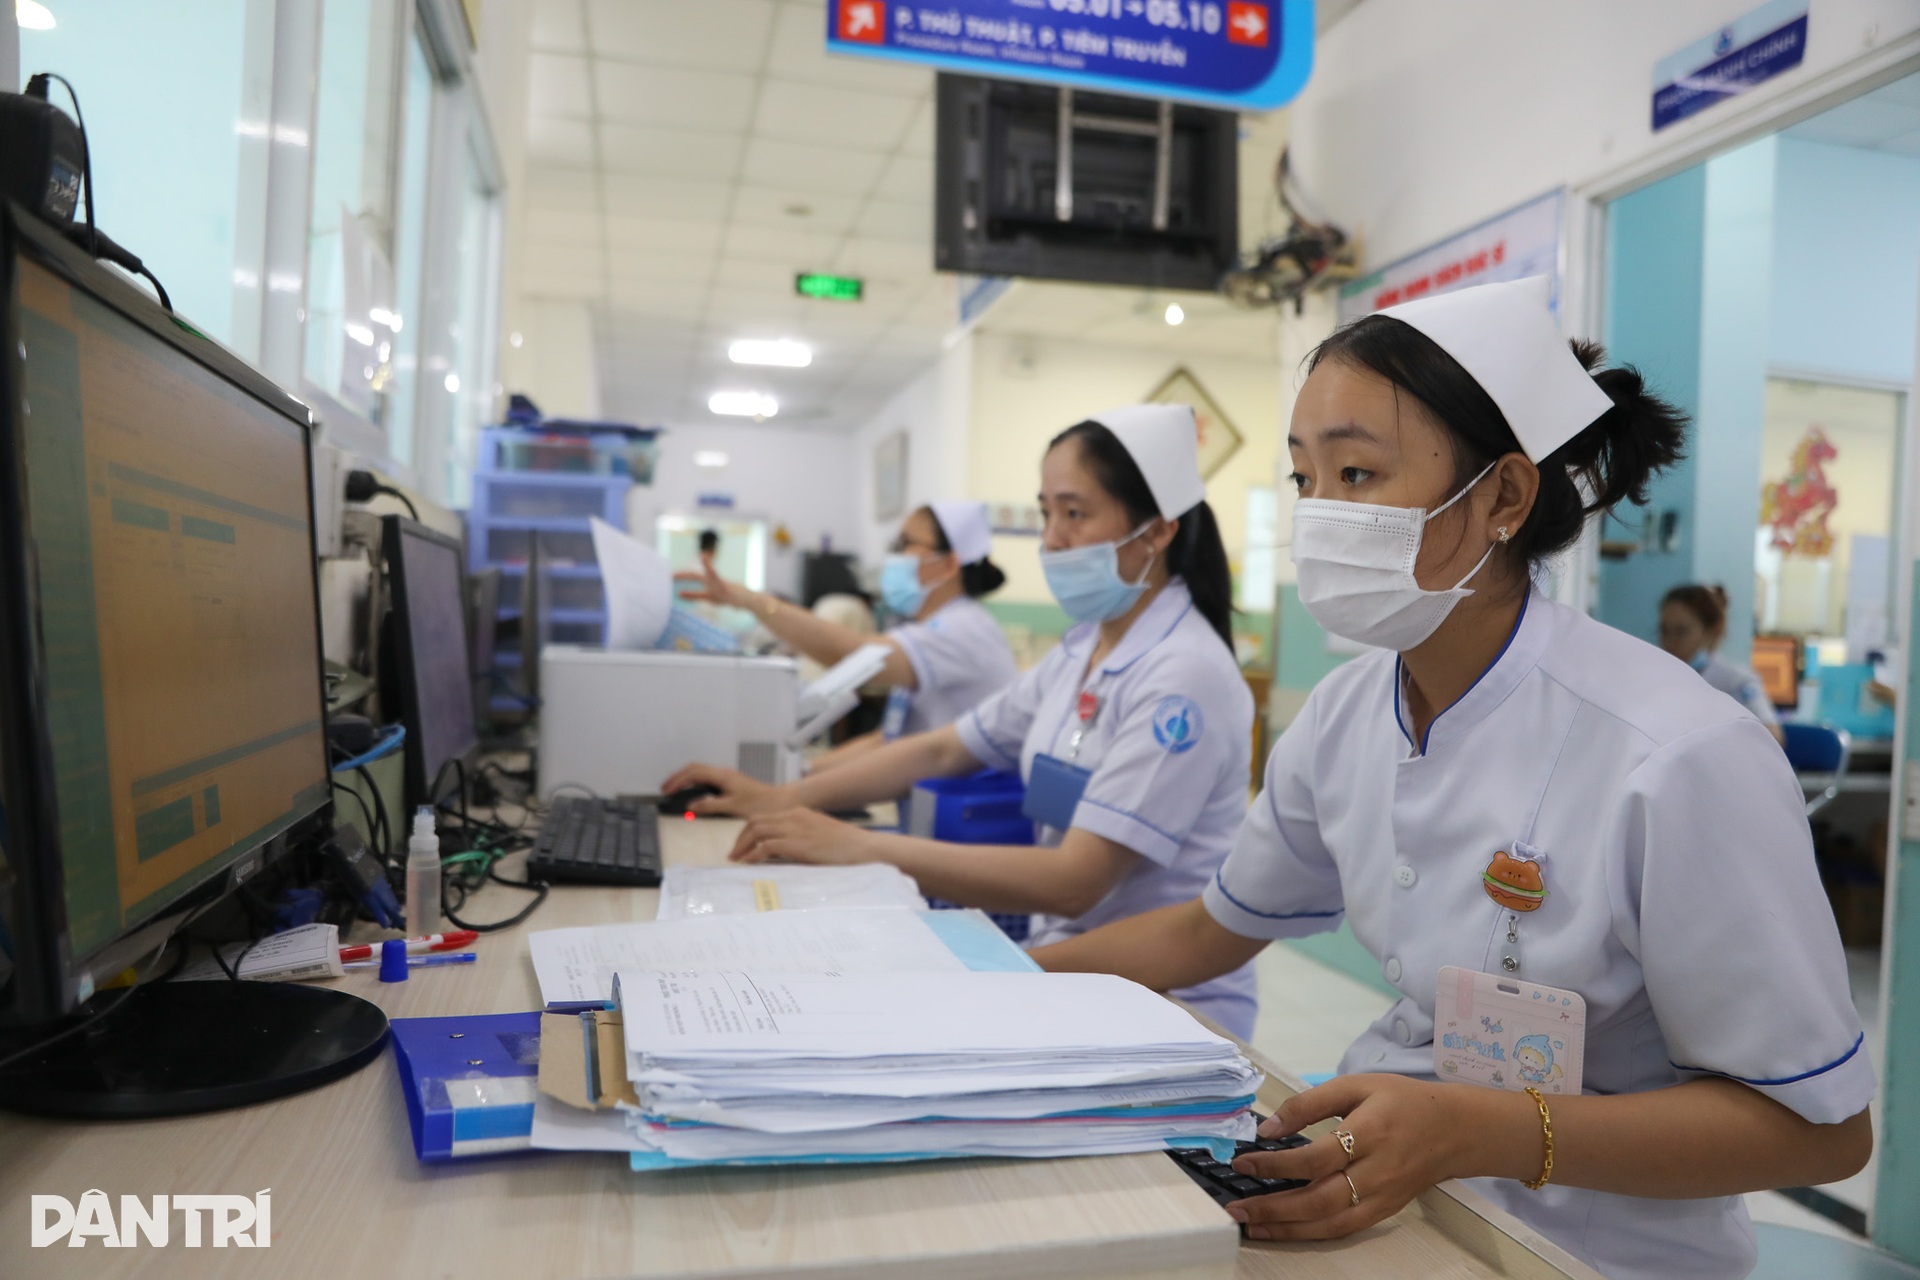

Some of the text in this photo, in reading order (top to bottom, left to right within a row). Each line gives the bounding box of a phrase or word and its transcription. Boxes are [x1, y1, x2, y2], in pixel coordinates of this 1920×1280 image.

[895, 6, 914, 30] P.
[1039, 27, 1058, 49] P.
[1146, 0, 1222, 35] 05.10
